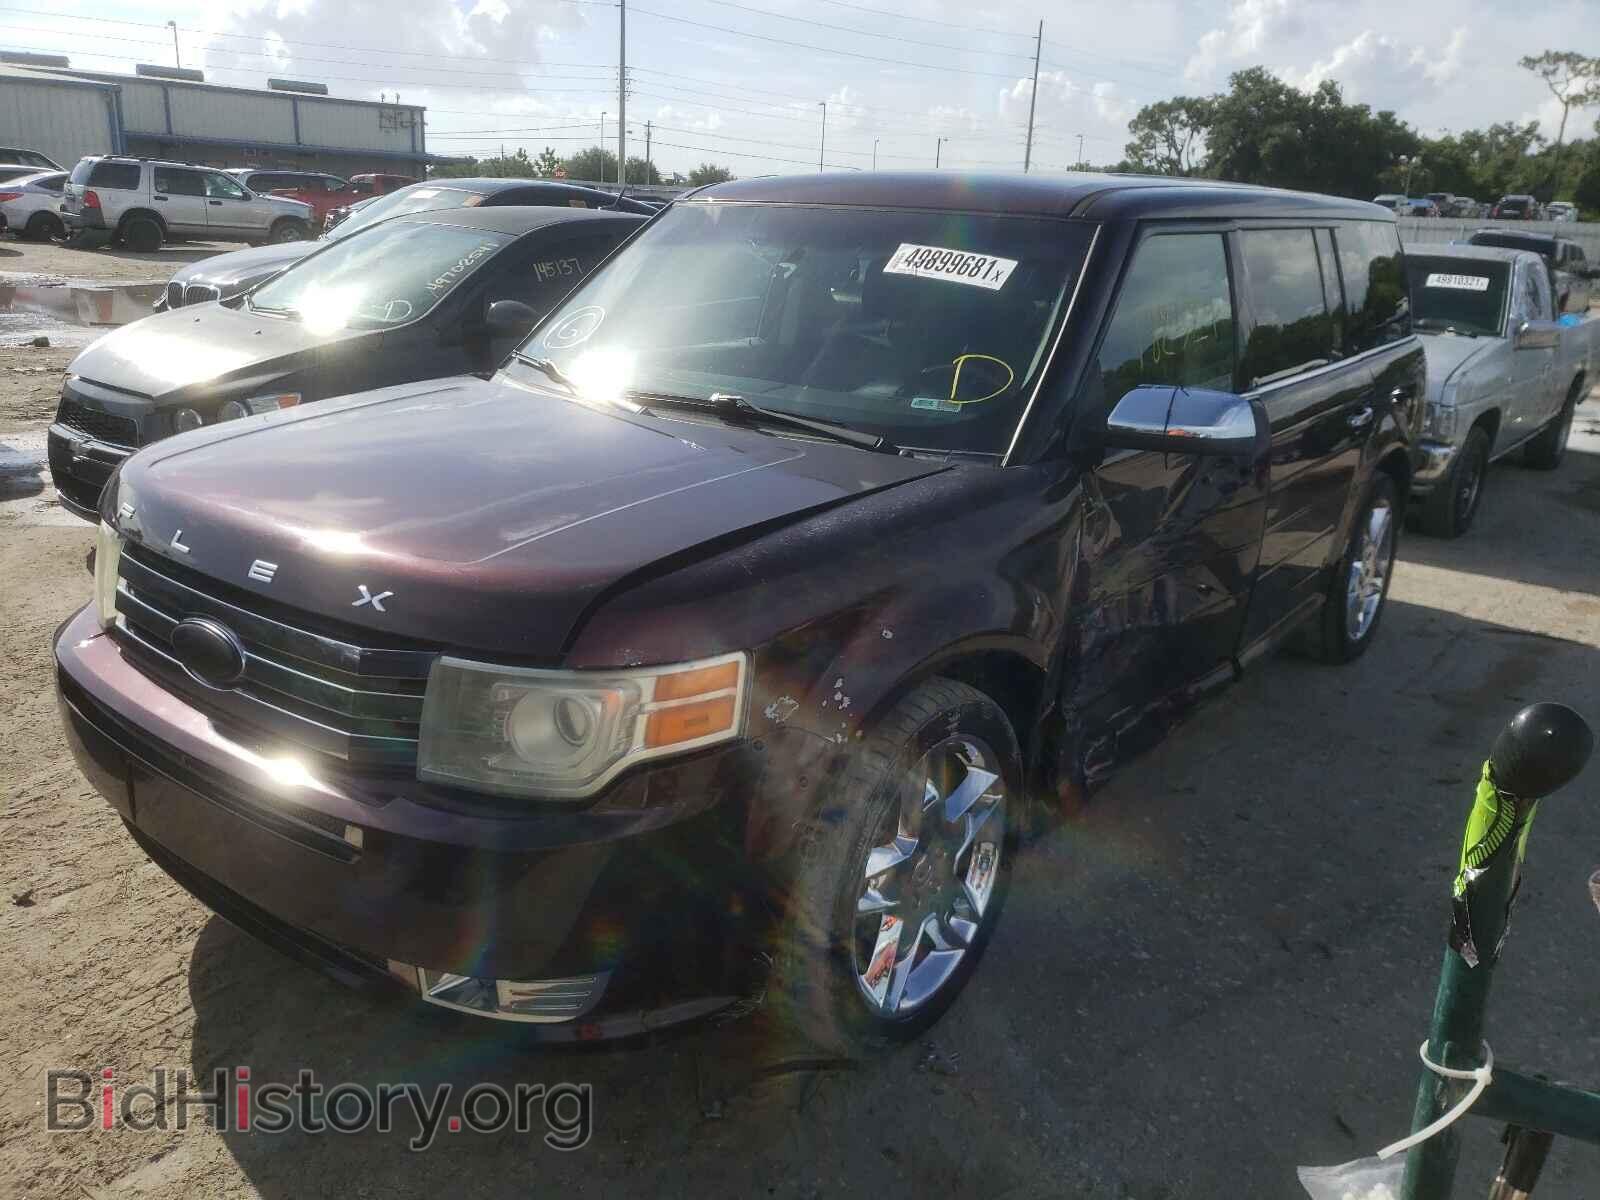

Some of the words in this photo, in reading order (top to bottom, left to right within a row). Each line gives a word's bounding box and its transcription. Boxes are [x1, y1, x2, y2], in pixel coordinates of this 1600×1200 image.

[533, 258, 583, 282] 145137
[904, 248, 998, 280] 49899681
[950, 354, 1014, 404] D
